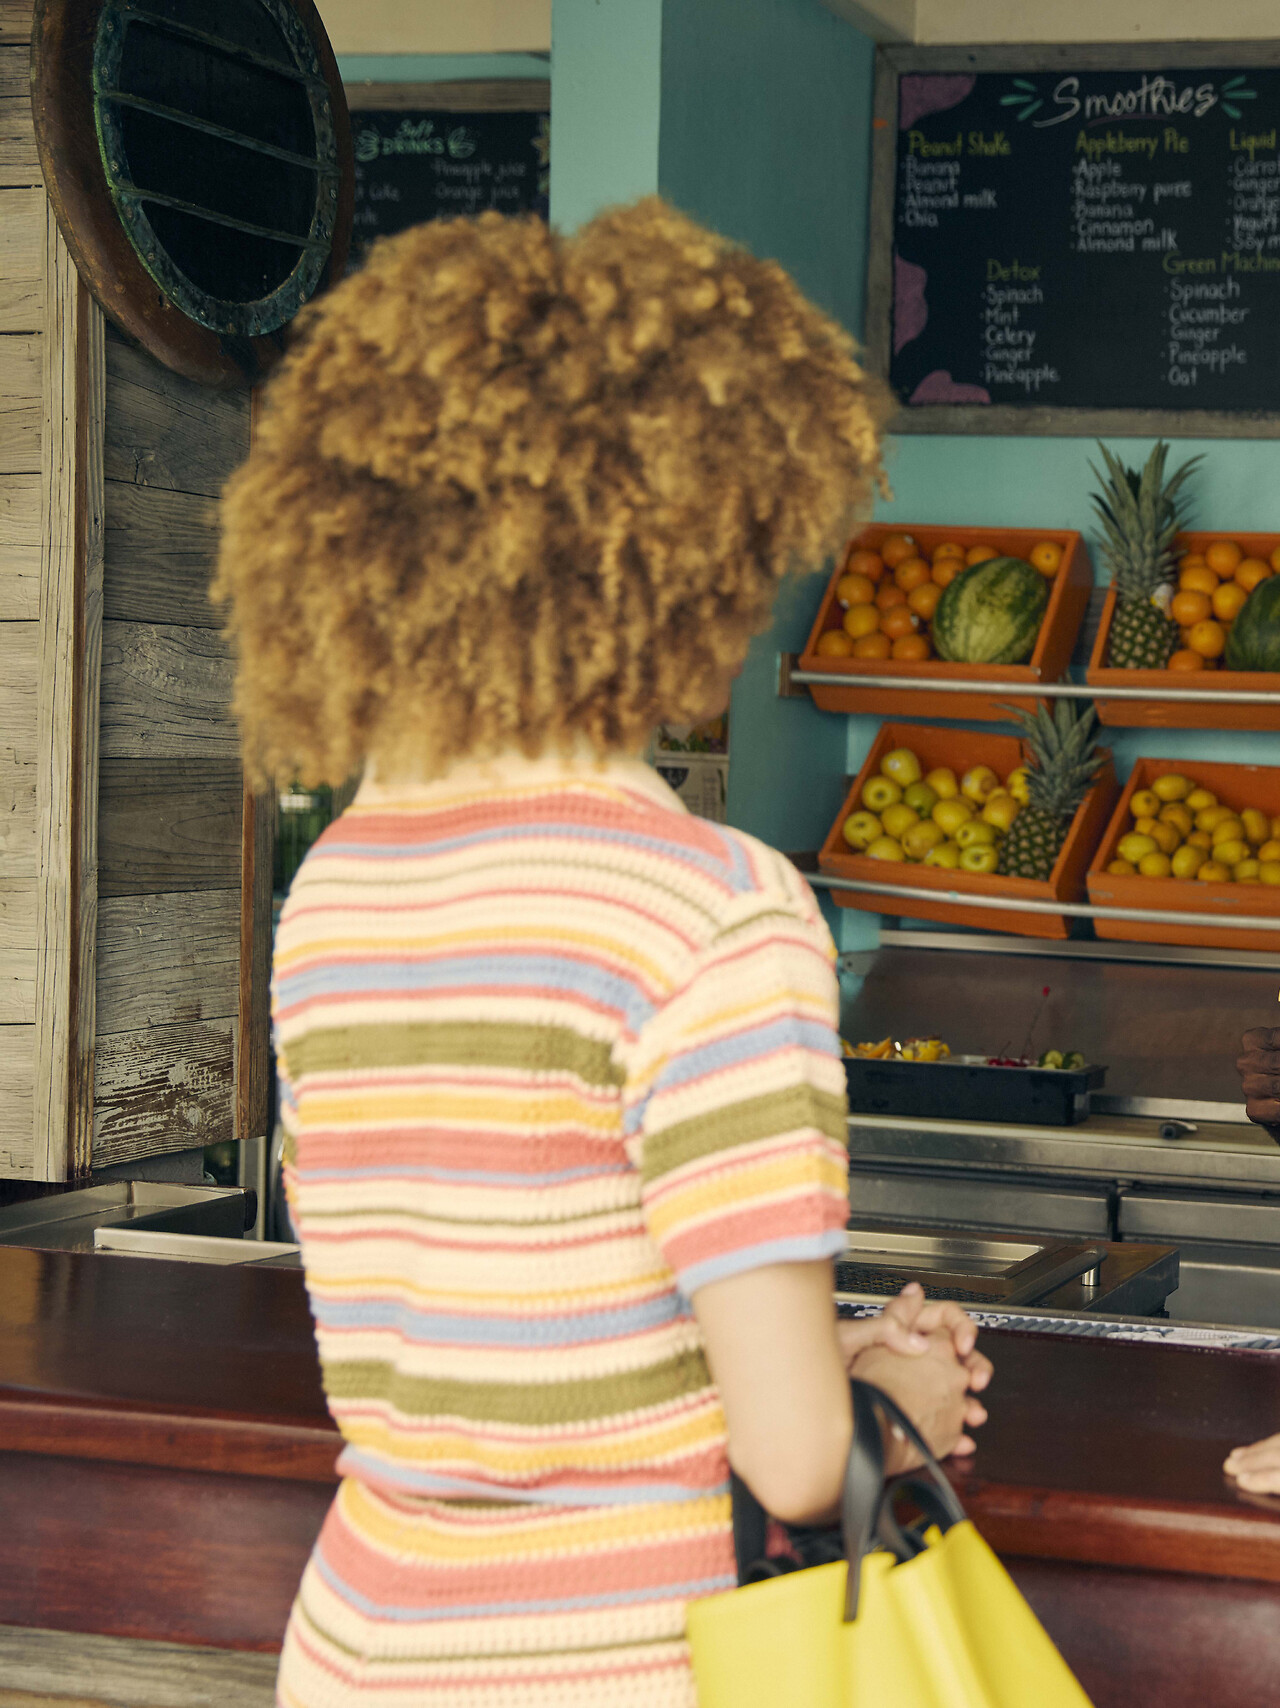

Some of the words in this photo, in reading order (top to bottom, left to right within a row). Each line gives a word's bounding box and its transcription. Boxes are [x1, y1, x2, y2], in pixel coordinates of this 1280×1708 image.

[1033, 75, 1219, 128] Smoothies
[967, 131, 1011, 156] Shake
[1075, 130, 1158, 162] Appleberry
[1163, 127, 1189, 153] Pie
[1229, 128, 1276, 161] Liquid
[906, 154, 960, 176] Banana
[1078, 158, 1121, 183] Apple
[963, 188, 998, 209] milk
[1075, 178, 1147, 203] Raspberry
[1075, 199, 1133, 219] Banana
[1233, 192, 1280, 218] Orange
[1077, 218, 1154, 236] Cinnamon
[1077, 233, 1135, 252] Almond
[1142, 228, 1178, 251] milk
[1232, 231, 1265, 257] Soy
[986, 258, 1042, 281] Detox
[1162, 249, 1216, 275] Green
[986, 283, 1043, 306] Spinach
[1169, 274, 1240, 308] Spinach
[984, 304, 1019, 325] Mint
[1168, 302, 1251, 325] Cucumber
[984, 325, 1036, 347] Celery
[1170, 323, 1222, 350] Ginger
[985, 345, 1033, 369] Ginger
[1168, 341, 1248, 374] Pineapple
[984, 362, 1060, 392] Pineapple
[1167, 365, 1197, 386] Oat
